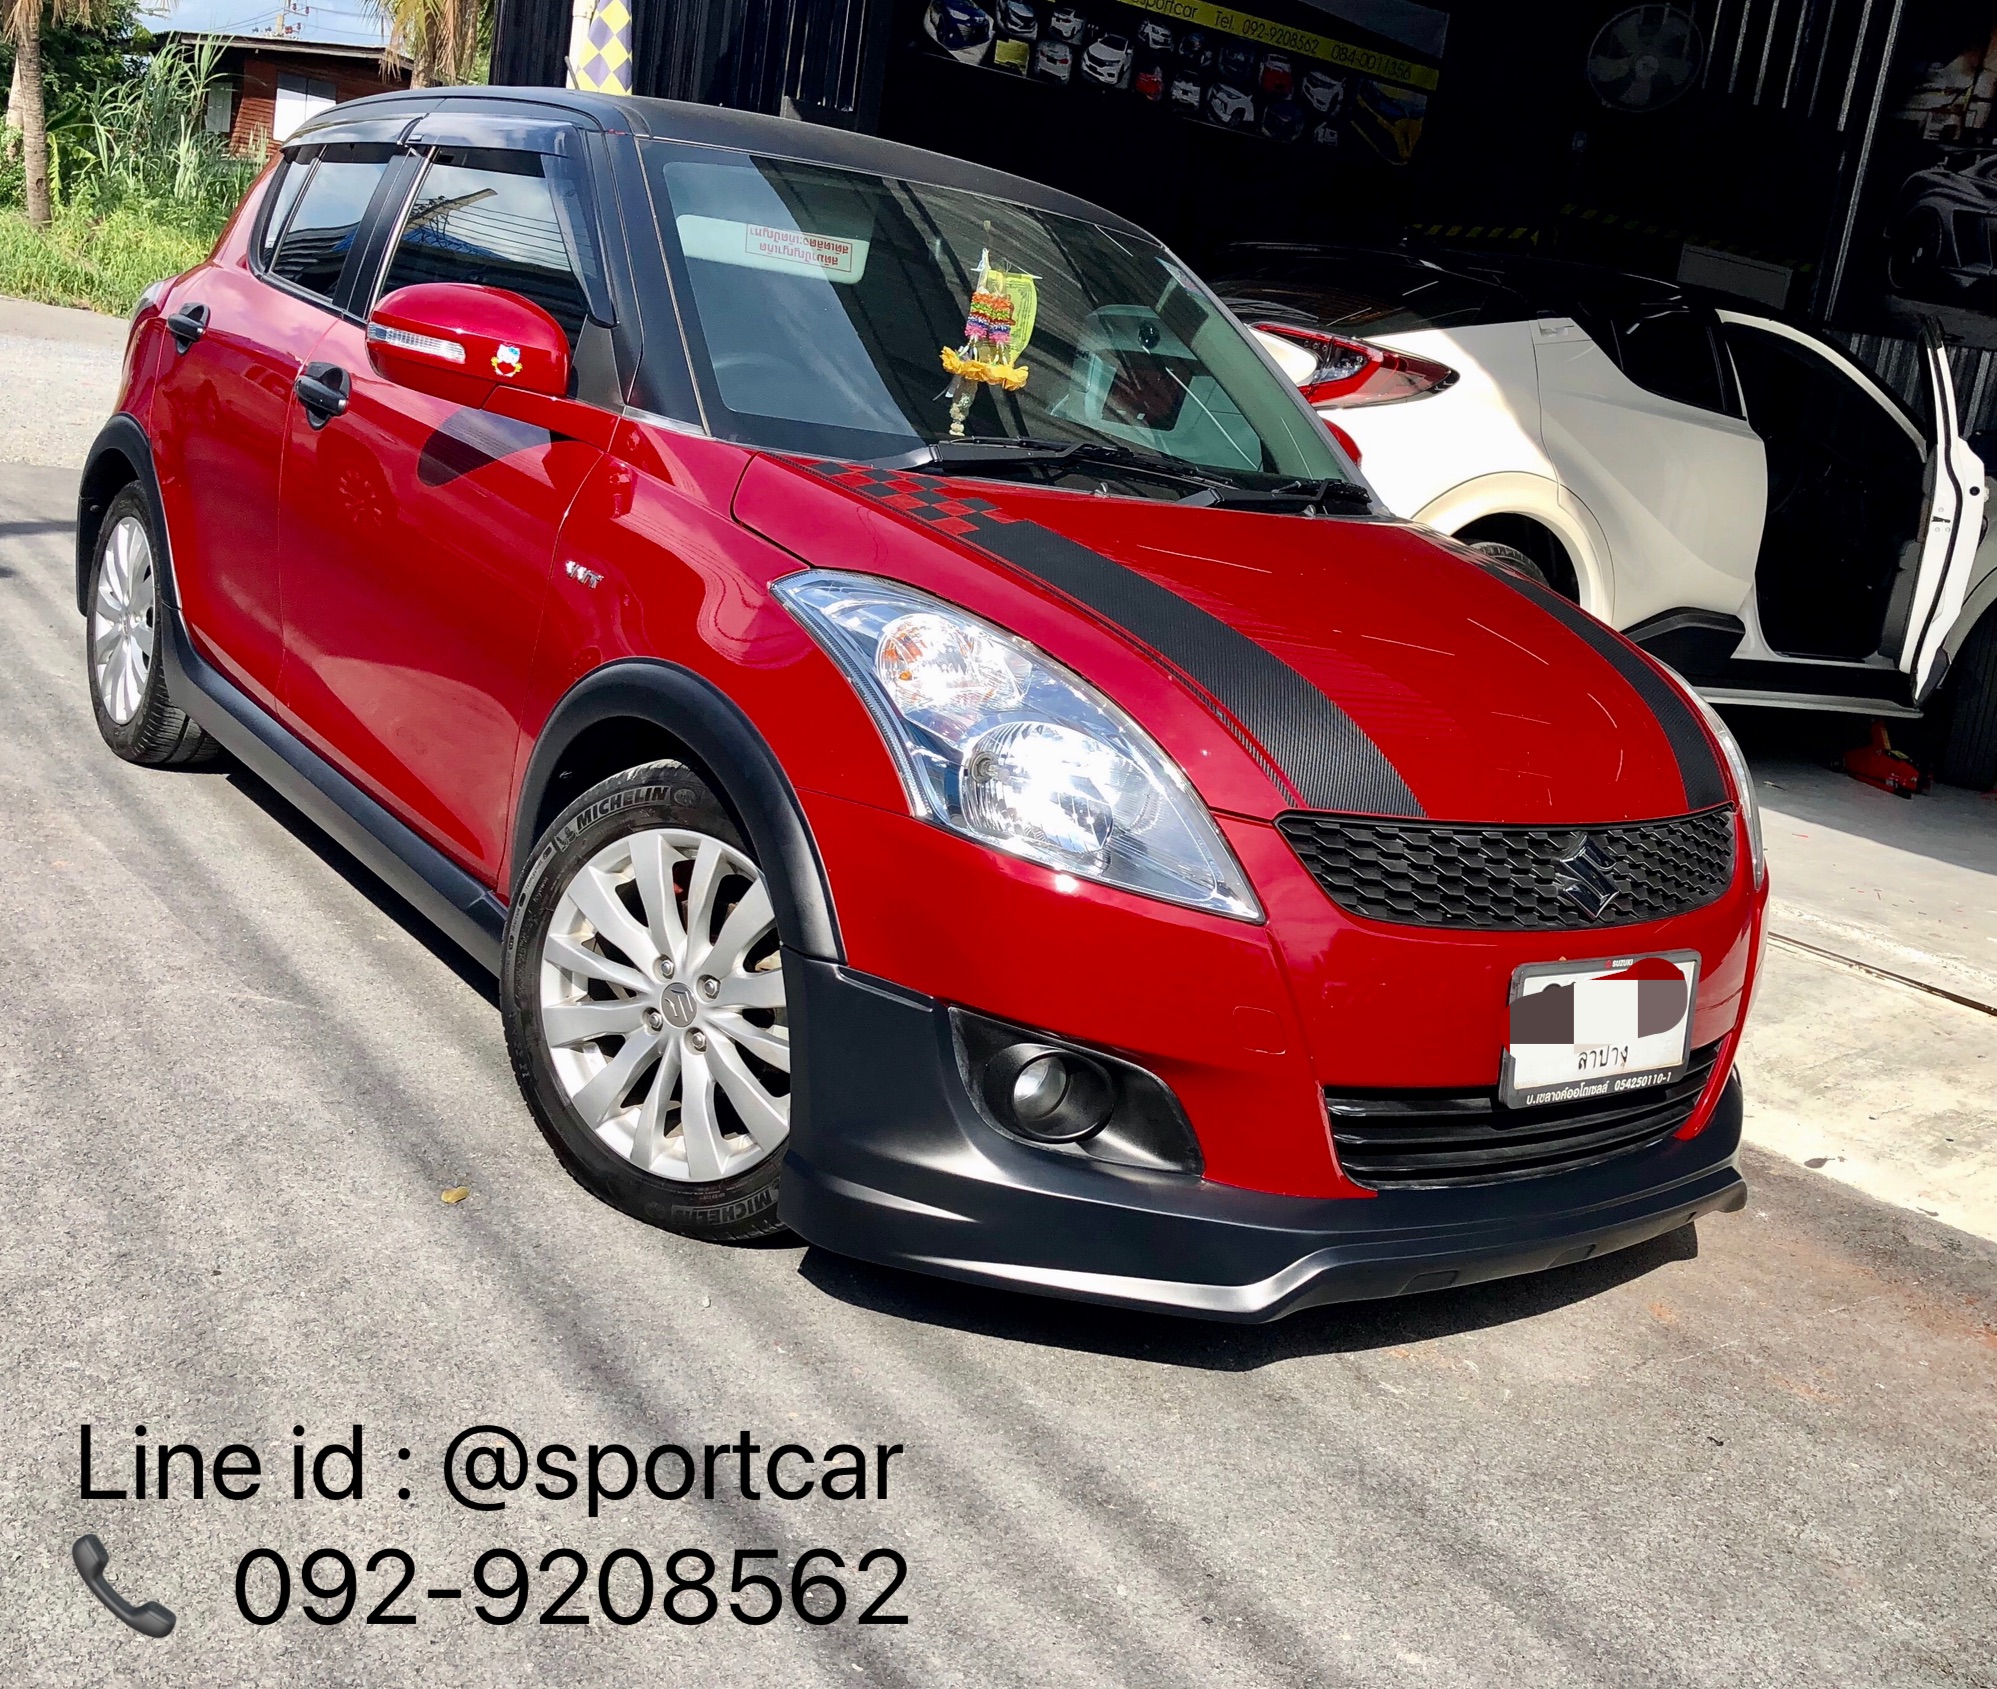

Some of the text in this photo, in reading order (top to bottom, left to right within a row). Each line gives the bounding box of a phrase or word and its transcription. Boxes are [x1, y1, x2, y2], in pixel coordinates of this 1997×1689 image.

[1214, 10, 1235, 31] Tel.
[1242, 18, 1320, 54] 092-9208562
[1330, 43, 1412, 80] 084-0011356
[576, 786, 670, 831] MICHELIN
[1612, 958, 1634, 968] SUZUKI
[1614, 1072, 1672, 1092] 054250110-1
